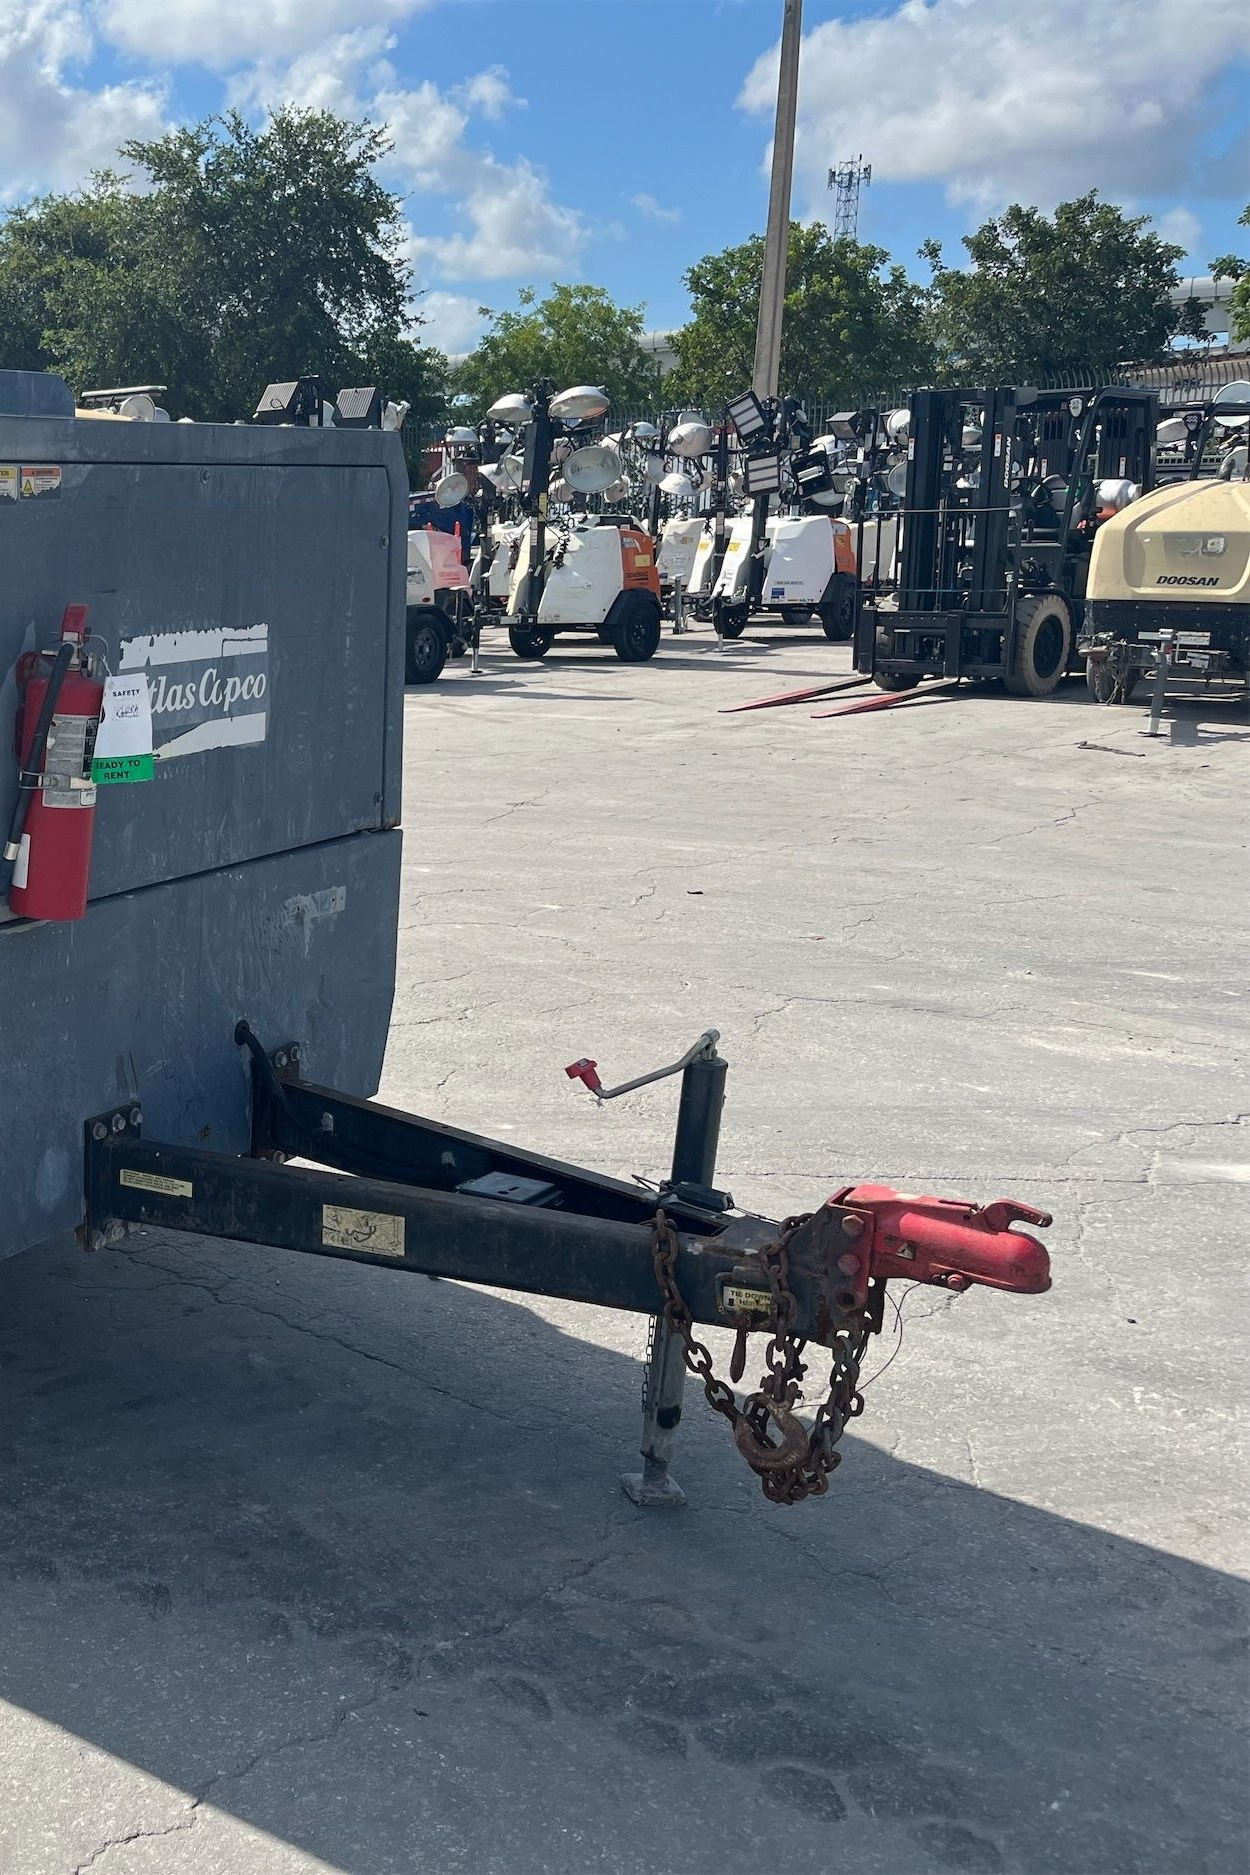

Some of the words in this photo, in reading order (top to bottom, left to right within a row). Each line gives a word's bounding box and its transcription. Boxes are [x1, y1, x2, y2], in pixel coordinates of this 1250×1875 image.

[1155, 575, 1220, 586] DOOSAN
[146, 675, 196, 714] tlas
[128, 759, 141, 767] TO
[104, 771, 130, 780] RENT
[730, 1290, 743, 1298] TIE
